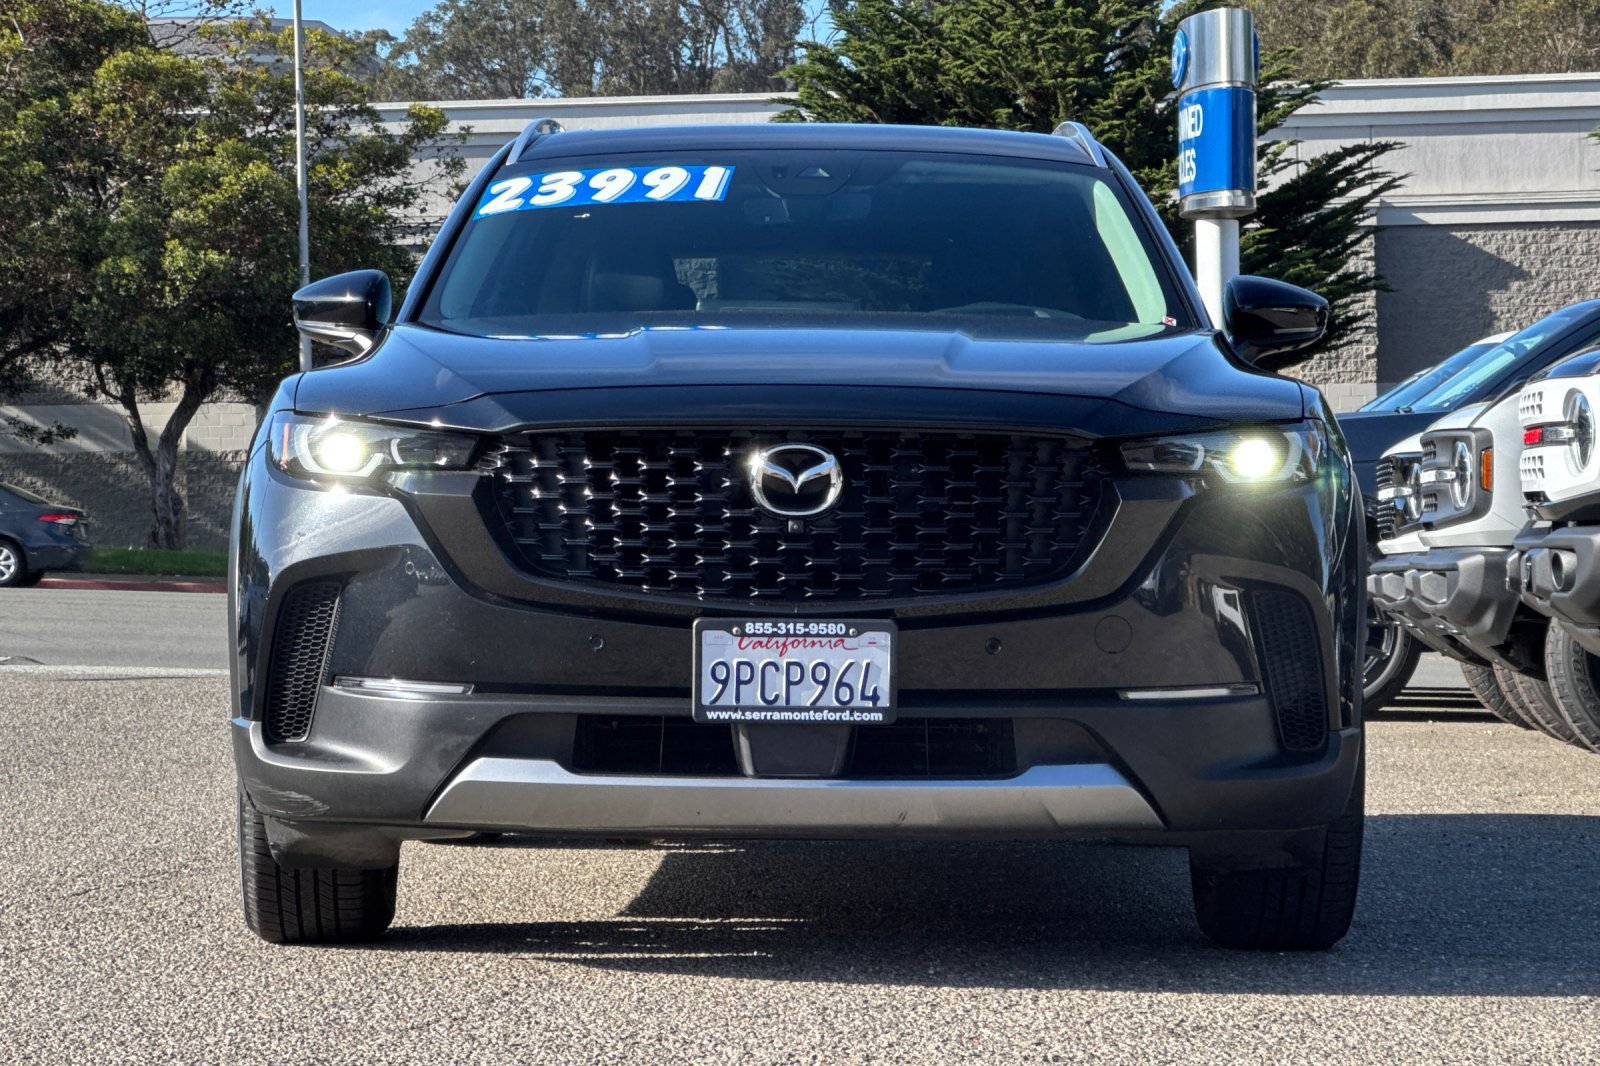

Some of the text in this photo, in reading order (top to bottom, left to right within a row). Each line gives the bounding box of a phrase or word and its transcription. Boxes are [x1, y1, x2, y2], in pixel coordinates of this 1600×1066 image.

[479, 166, 731, 215] 23991
[745, 622, 846, 635] 855-315-9580
[737, 636, 859, 657] California
[708, 659, 881, 707] 9PCP964
[706, 709, 883, 721] www.serramonteford.com
